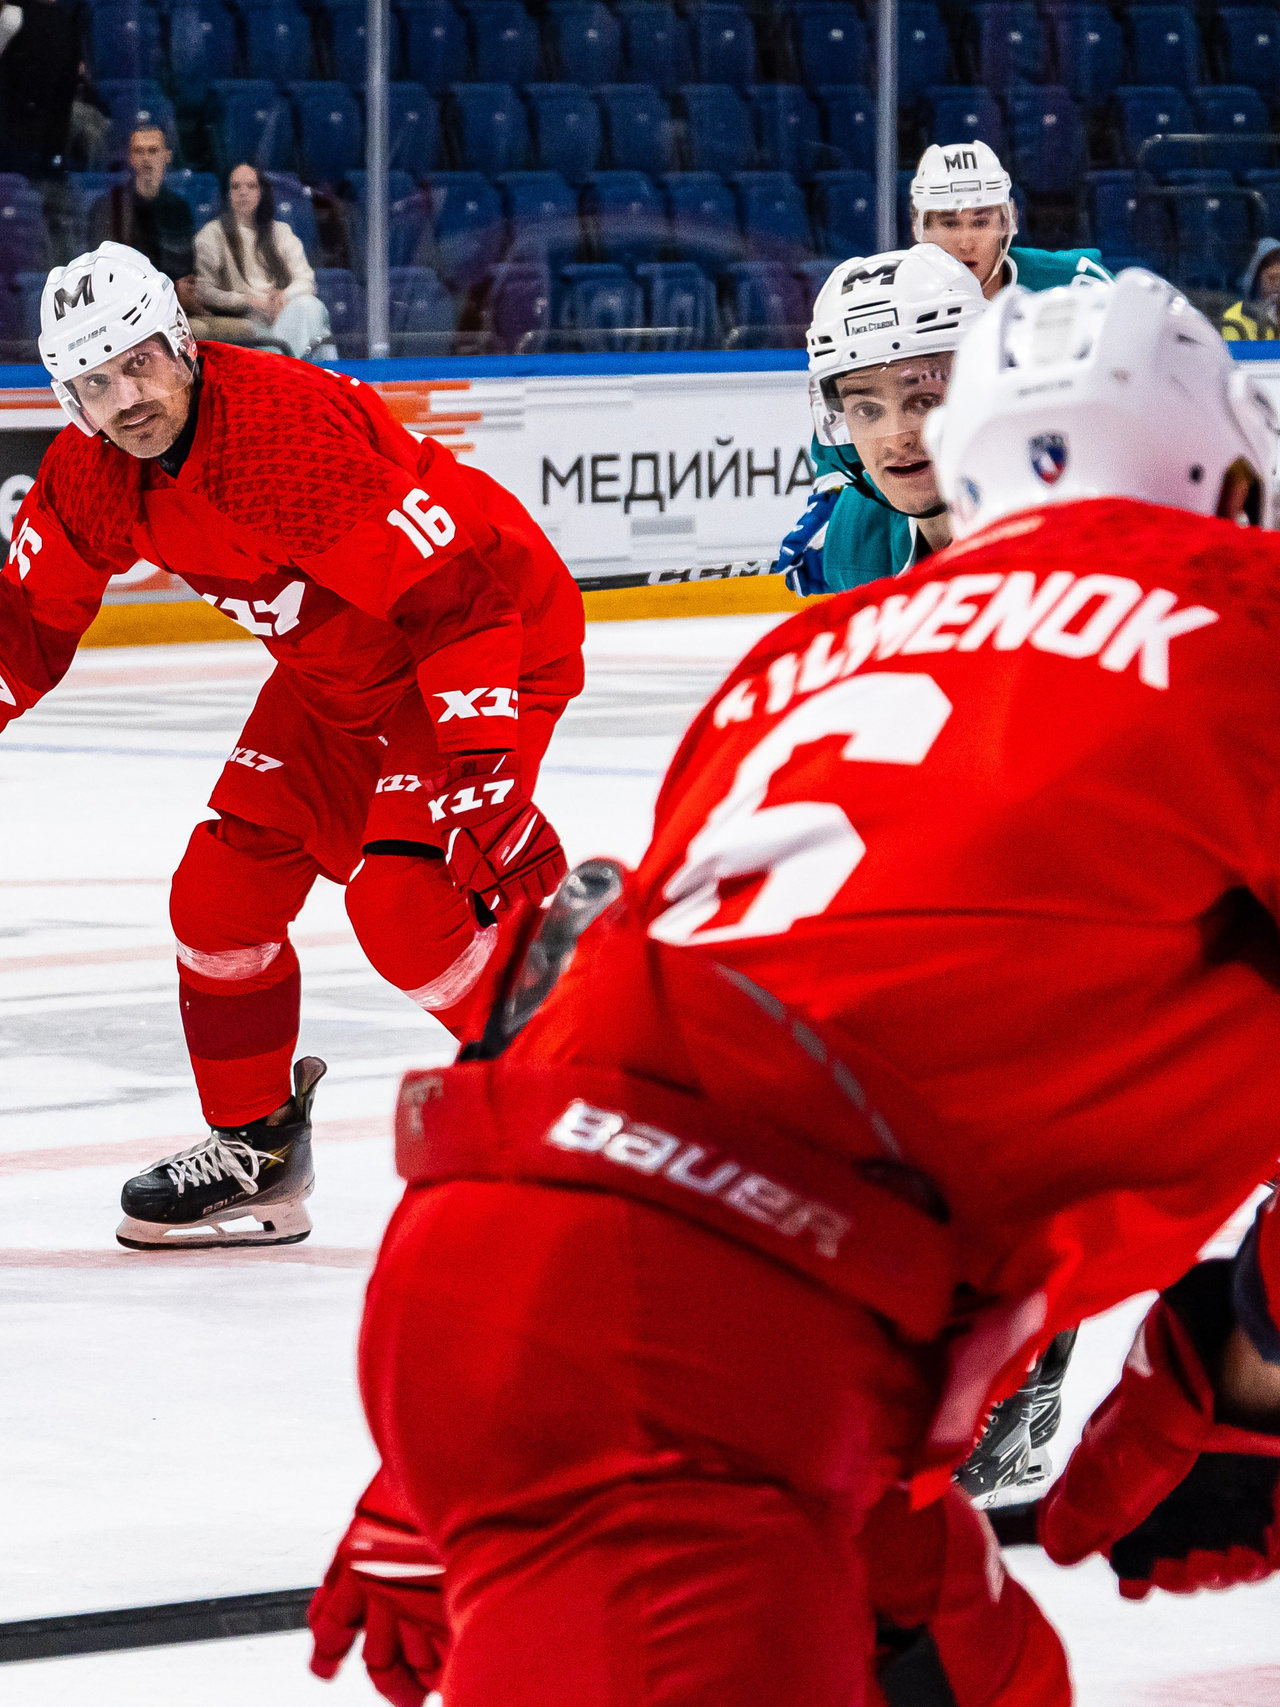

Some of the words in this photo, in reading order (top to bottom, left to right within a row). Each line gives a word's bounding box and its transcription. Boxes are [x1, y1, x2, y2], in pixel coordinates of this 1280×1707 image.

[542, 434, 816, 515] МЕДИЙНА
[387, 487, 456, 559] 16
[432, 687, 519, 723] X1
[648, 672, 953, 947] 6
